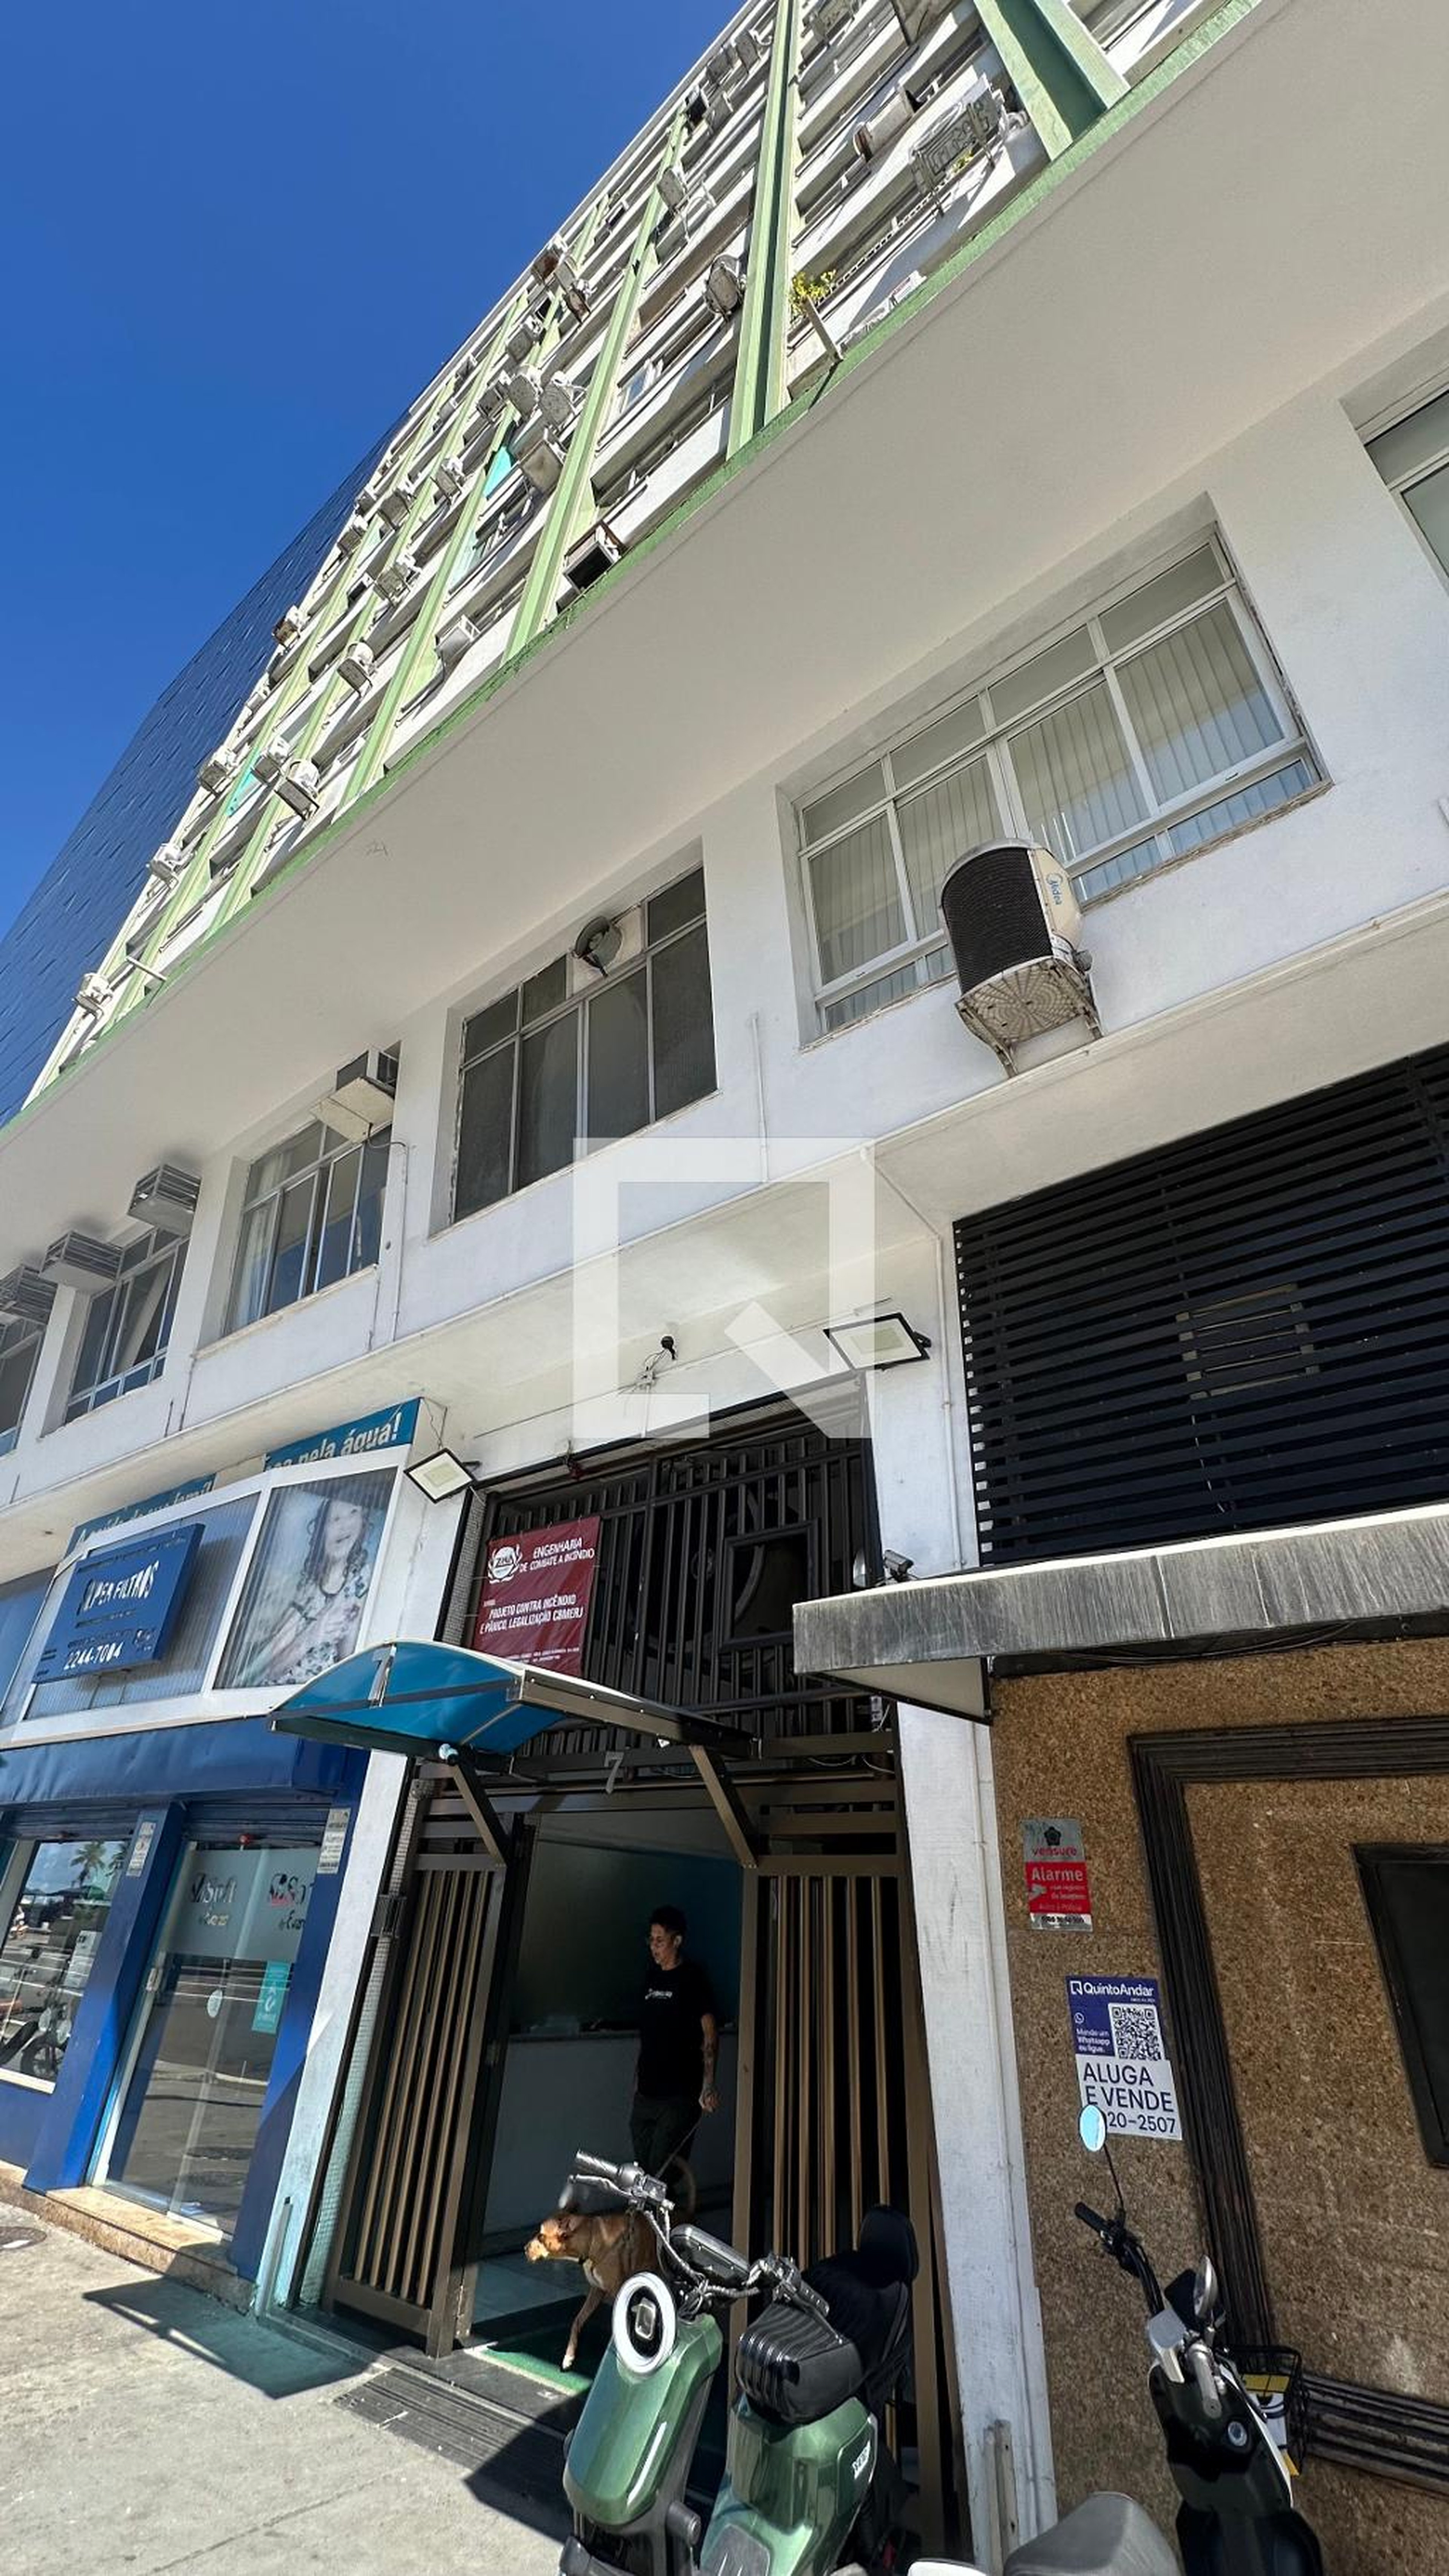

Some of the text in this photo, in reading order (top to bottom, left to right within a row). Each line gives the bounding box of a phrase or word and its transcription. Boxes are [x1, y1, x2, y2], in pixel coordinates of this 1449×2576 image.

[341, 1412, 401, 1453] água!
[533, 1537, 582, 1558] ENGENHARIA
[519, 1563, 528, 1572] DE
[530, 1557, 557, 1570] COMBATE
[558, 1555, 563, 1563] A
[489, 1594, 577, 1619] PROJETO CONTRA INCÊNDIO
[480, 1623, 485, 1634] E
[604, 1752, 624, 1794] 7
[1032, 1867, 1083, 1881] Alarme
[1083, 1982, 1154, 1996] QuintoAndar
[1083, 2062, 1154, 2086] ALUGA
[1086, 2086, 1174, 2112] E VENDE
[1107, 2112, 1175, 2133] 20-2507
